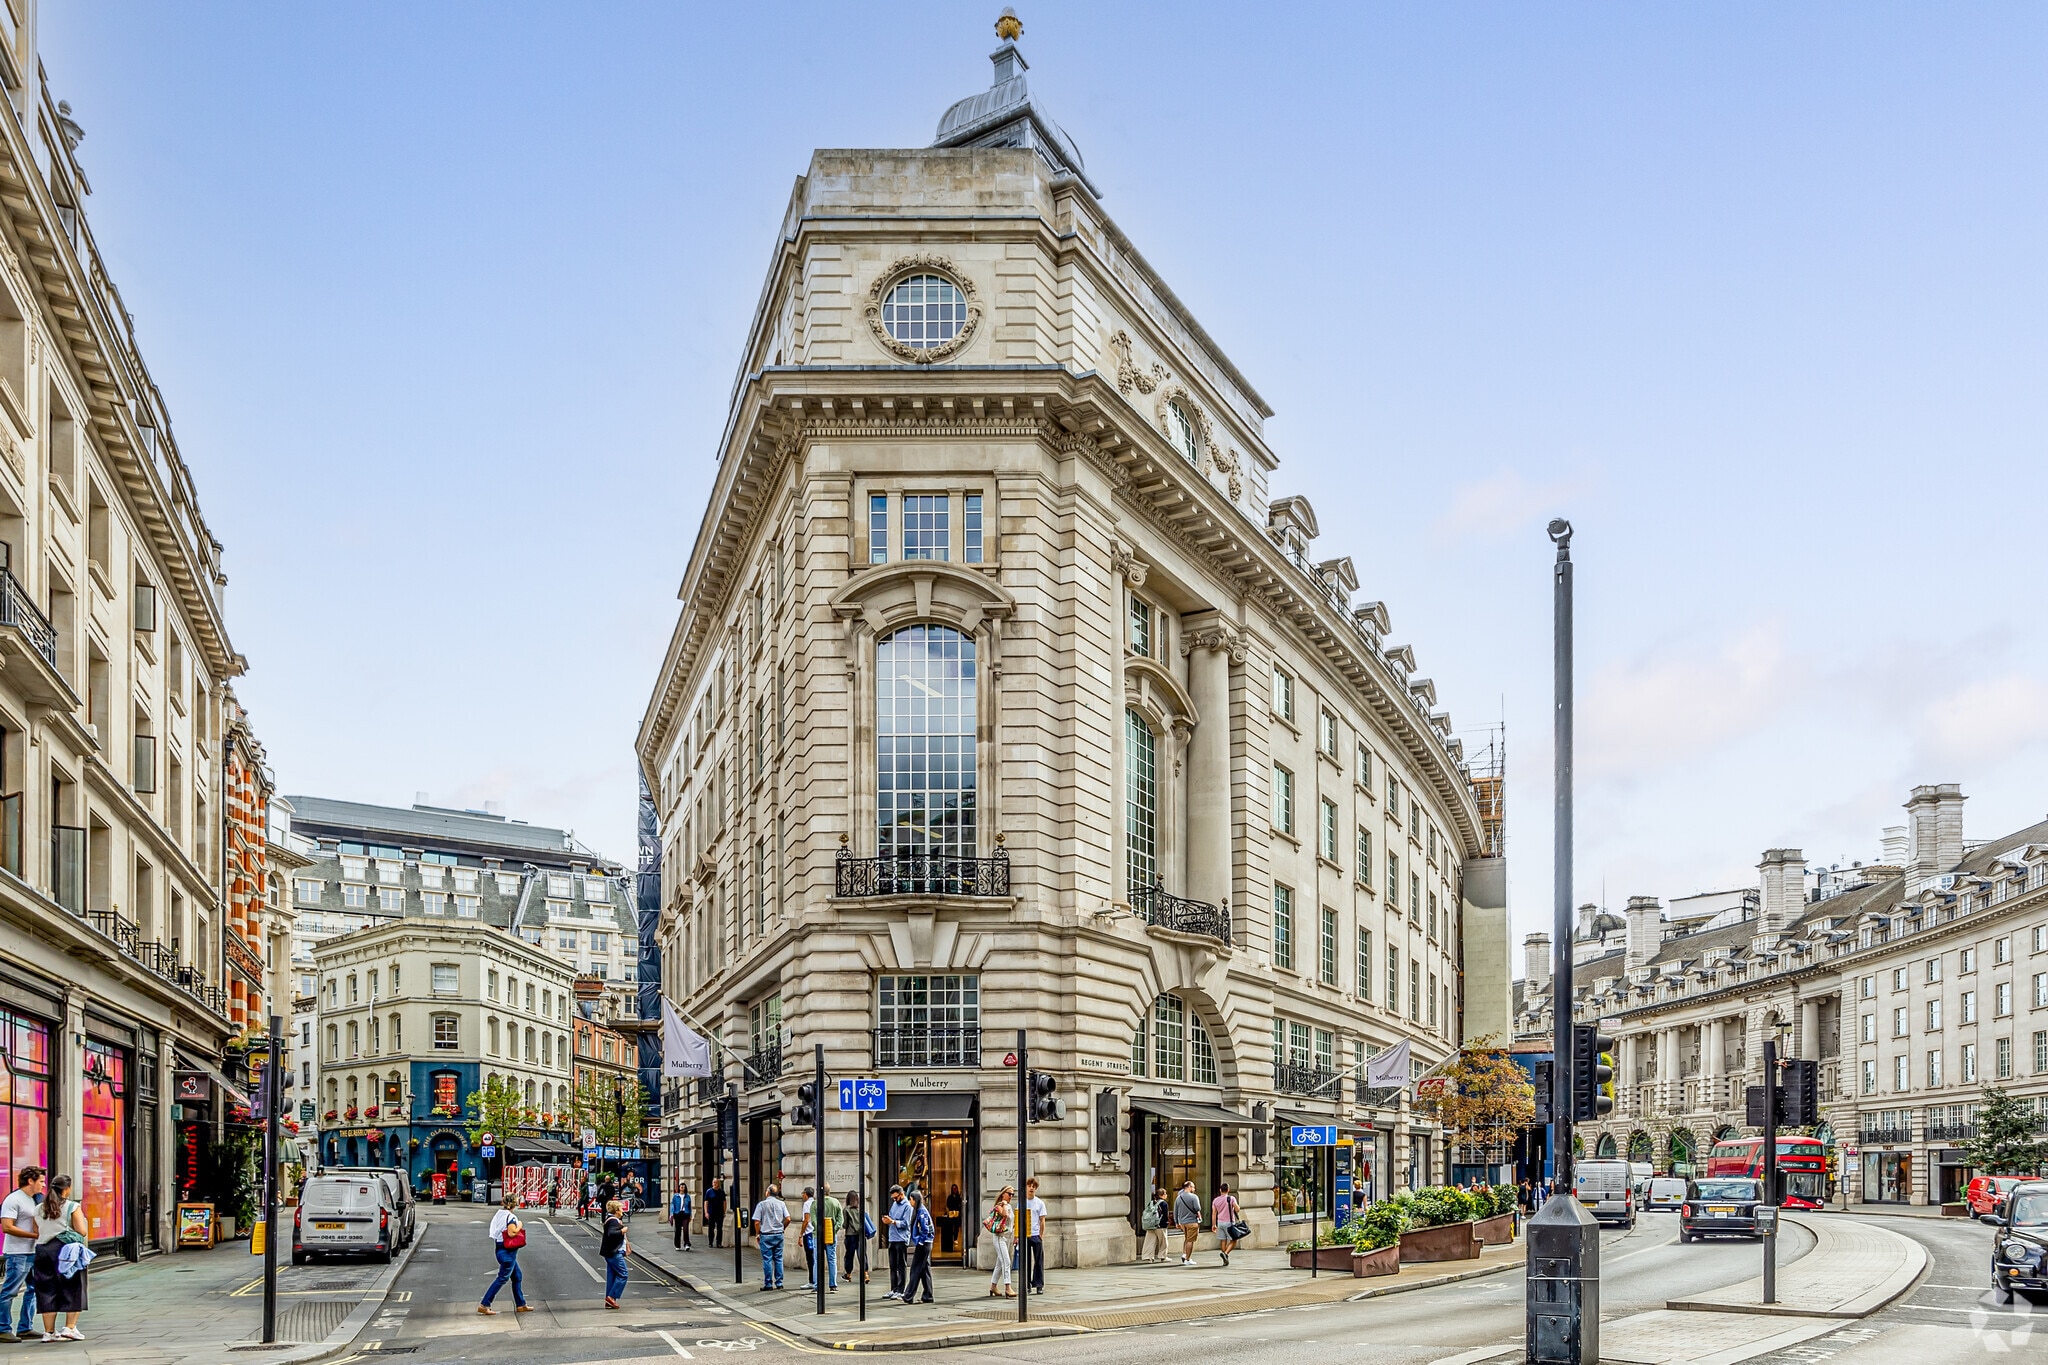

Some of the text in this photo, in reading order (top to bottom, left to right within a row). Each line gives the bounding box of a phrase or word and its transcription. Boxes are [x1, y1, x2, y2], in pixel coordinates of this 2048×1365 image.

[671, 1060, 704, 1070] Mulberry
[1081, 1058, 1103, 1068] REGENT
[1106, 1061, 1125, 1070] STREET
[910, 1076, 949, 1089] Mulberry
[1375, 1074, 1404, 1082] Mulberry
[1162, 1087, 1181, 1099] Mulberry
[1100, 1115, 1115, 1127] 100
[423, 1136, 431, 1149] THE
[629, 1176, 645, 1184] FOR
